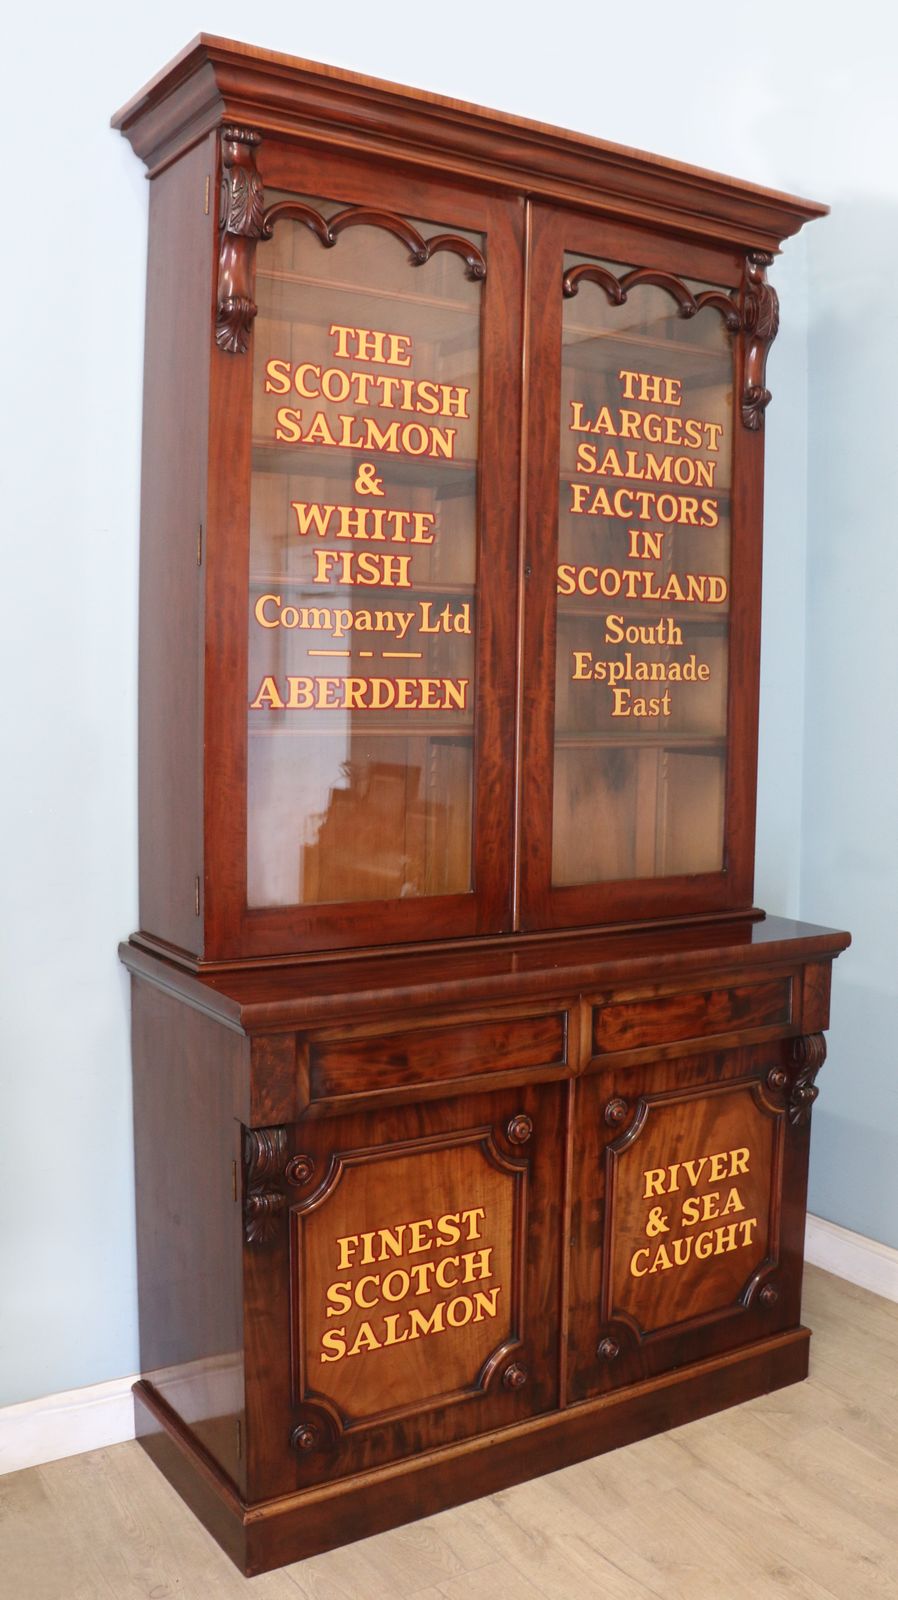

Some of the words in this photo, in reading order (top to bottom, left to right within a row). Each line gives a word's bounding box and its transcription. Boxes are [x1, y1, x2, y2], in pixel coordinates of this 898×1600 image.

[329, 324, 412, 367] THE
[264, 359, 470, 419] SCOTTISH
[619, 370, 682, 406] THE
[275, 408, 457, 460] SALMON
[570, 401, 723, 451] LARGEST
[354, 462, 385, 497] &
[576, 443, 716, 488] SALMON
[291, 501, 436, 545] WHITE
[570, 483, 719, 527] FACTORS
[628, 530, 663, 559] IN
[313, 548, 412, 588] FISH
[556, 565, 728, 603] SCOTLAND
[254, 594, 414, 639] Company
[418, 602, 472, 635] Ltd
[605, 614, 684, 646] South
[572, 651, 711, 686] Esplanade
[250, 676, 469, 711] ABERDEEN
[611, 688, 672, 718] East
[642, 1146, 751, 1200] RIVER
[645, 1205, 670, 1239] &
[681, 1186, 746, 1228] SEA
[336, 1207, 487, 1271] FINEST
[629, 1217, 757, 1278] CAUGHT
[326, 1247, 494, 1319] SCOTCH
[319, 1286, 501, 1363] SALMON
